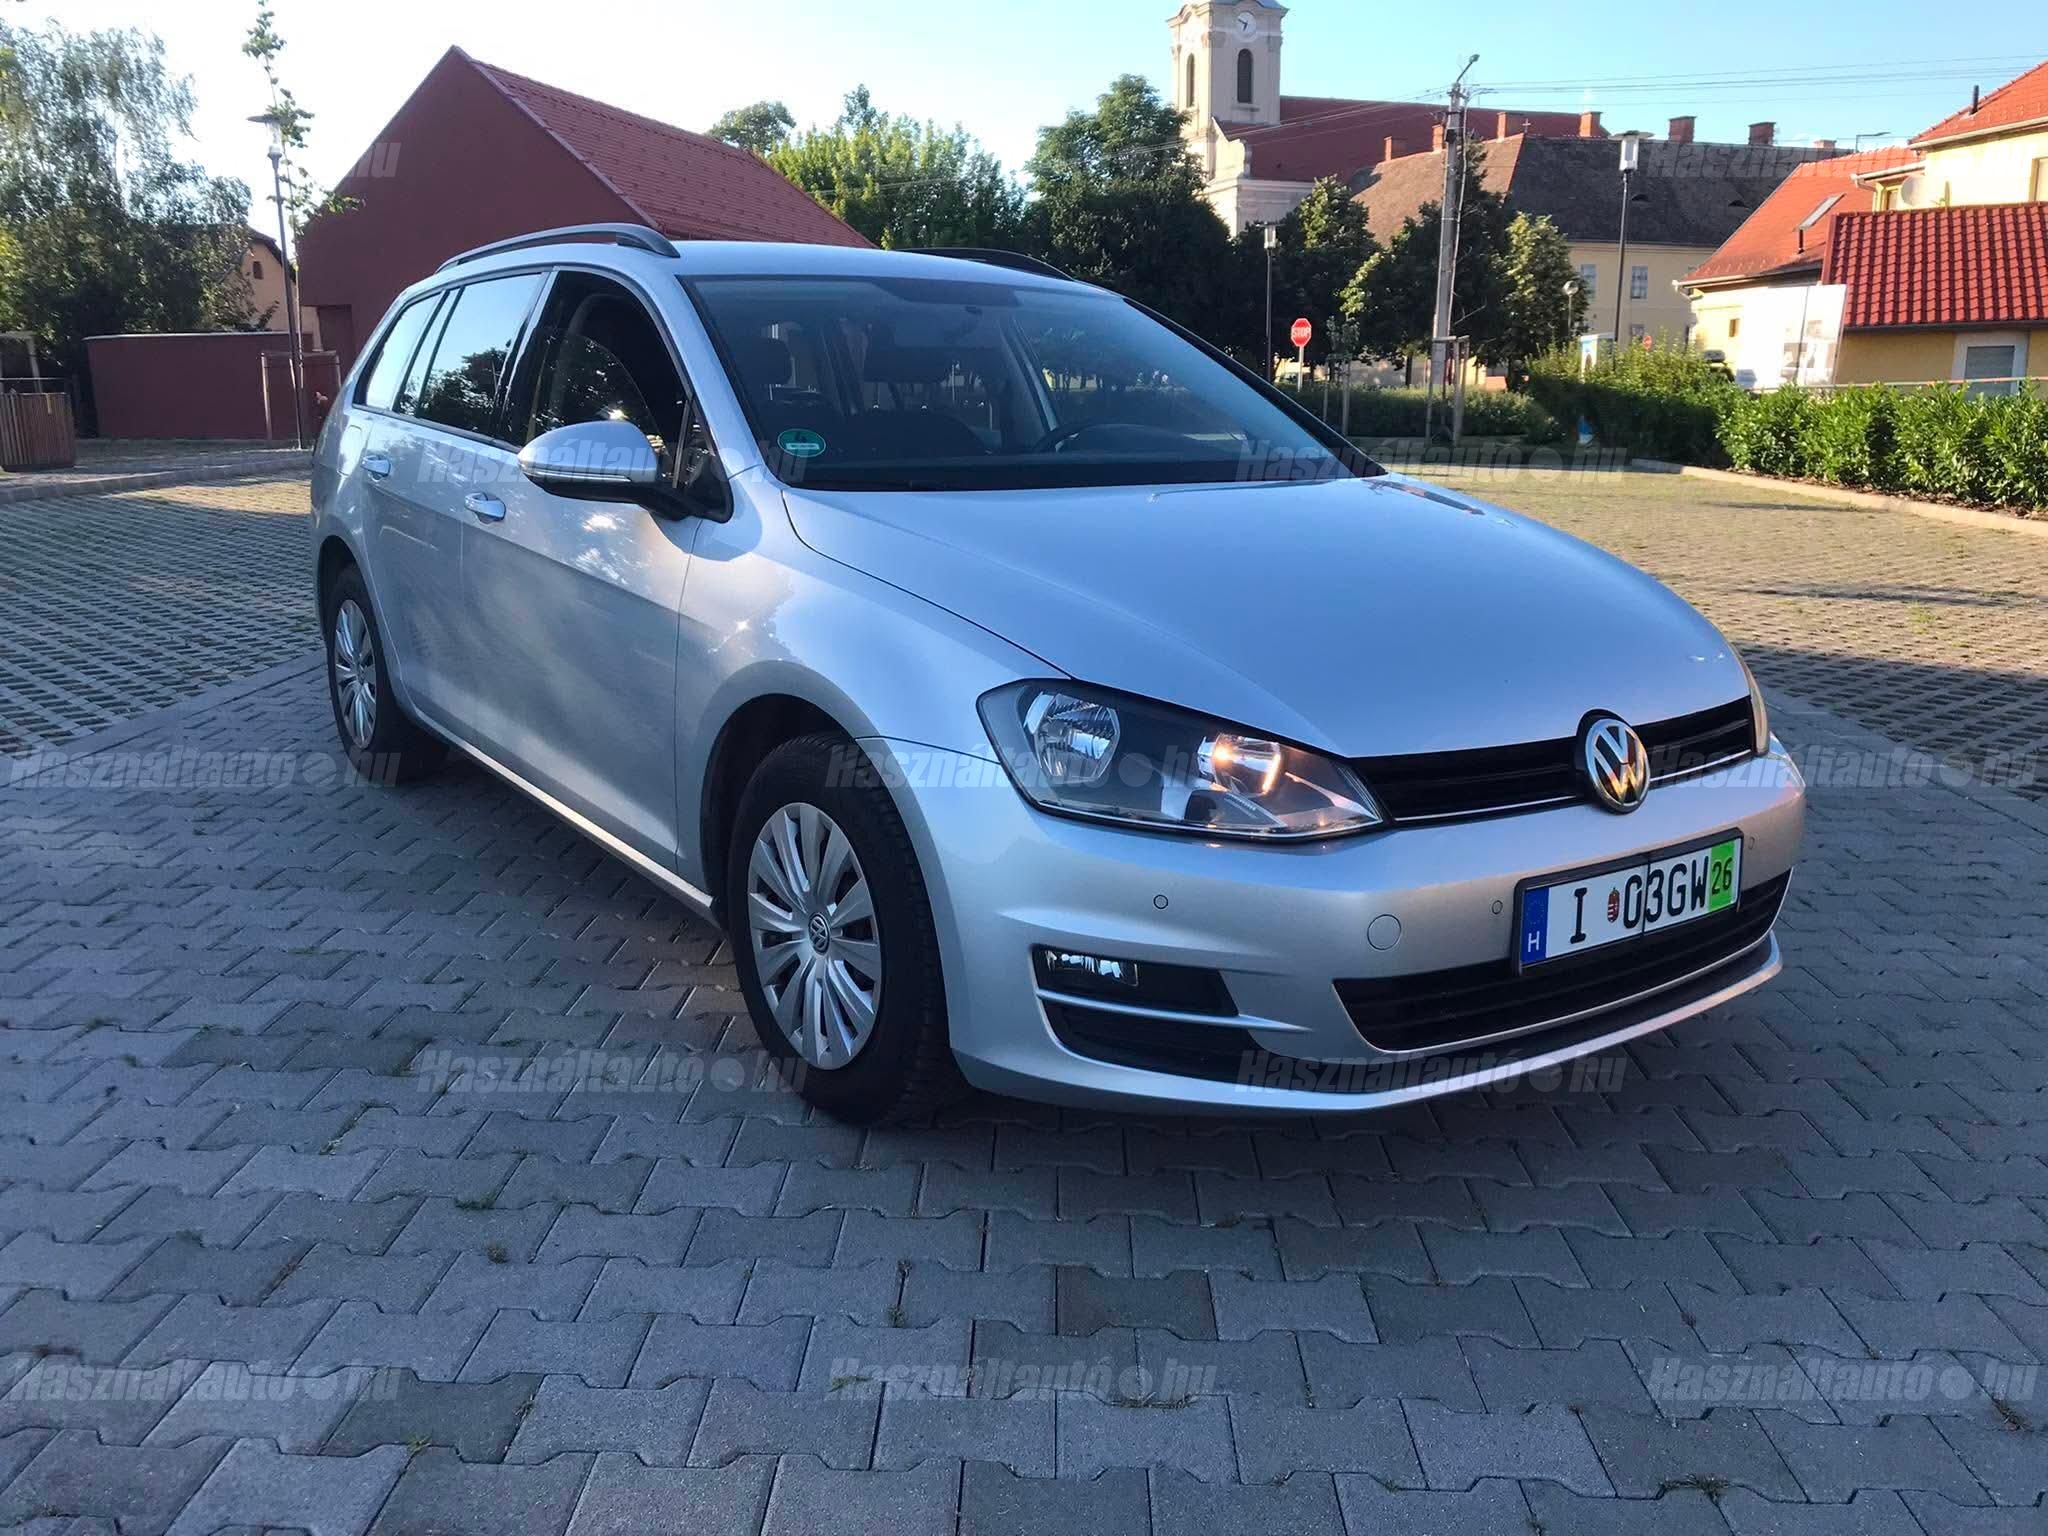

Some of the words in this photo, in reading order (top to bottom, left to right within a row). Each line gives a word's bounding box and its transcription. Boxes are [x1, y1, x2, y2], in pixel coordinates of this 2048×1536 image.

[1291, 327, 1311, 337] STOP
[1527, 930, 1541, 953] H
[1569, 887, 1588, 944] I
[1711, 857, 1733, 896] 26
